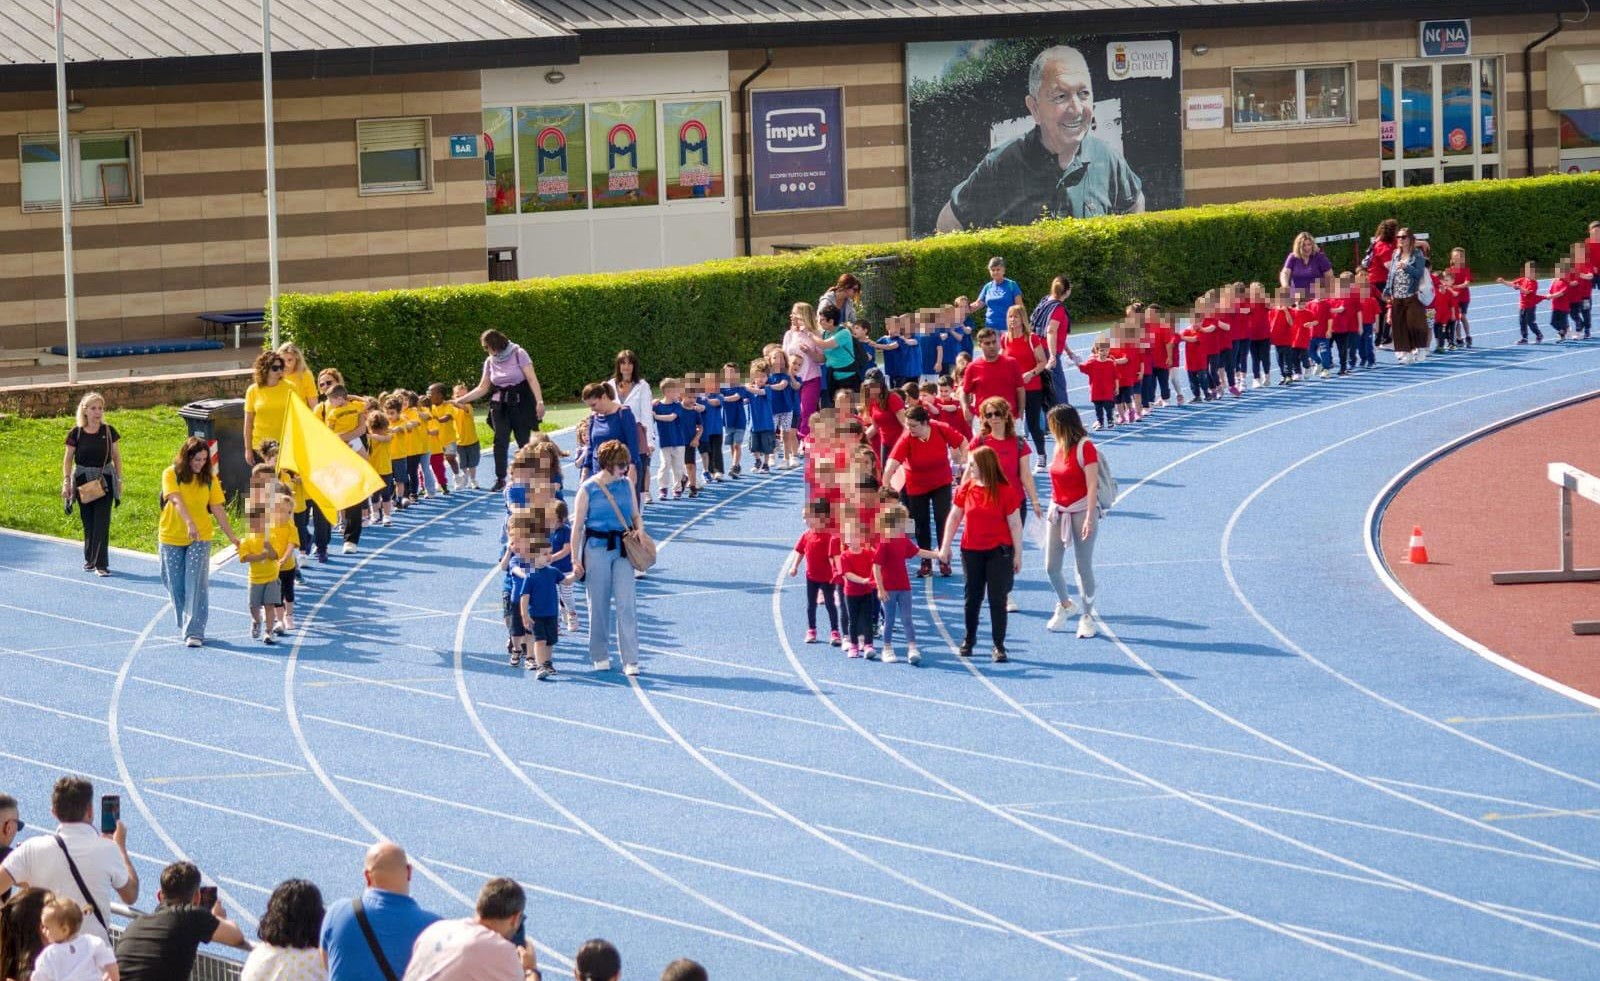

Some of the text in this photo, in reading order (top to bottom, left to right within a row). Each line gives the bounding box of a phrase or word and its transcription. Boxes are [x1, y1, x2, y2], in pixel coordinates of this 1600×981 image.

[1130, 51, 1168, 61] COMUNE
[1131, 60, 1168, 71] DI RIETI
[766, 122, 816, 141] imput
[455, 144, 472, 153] BAR
